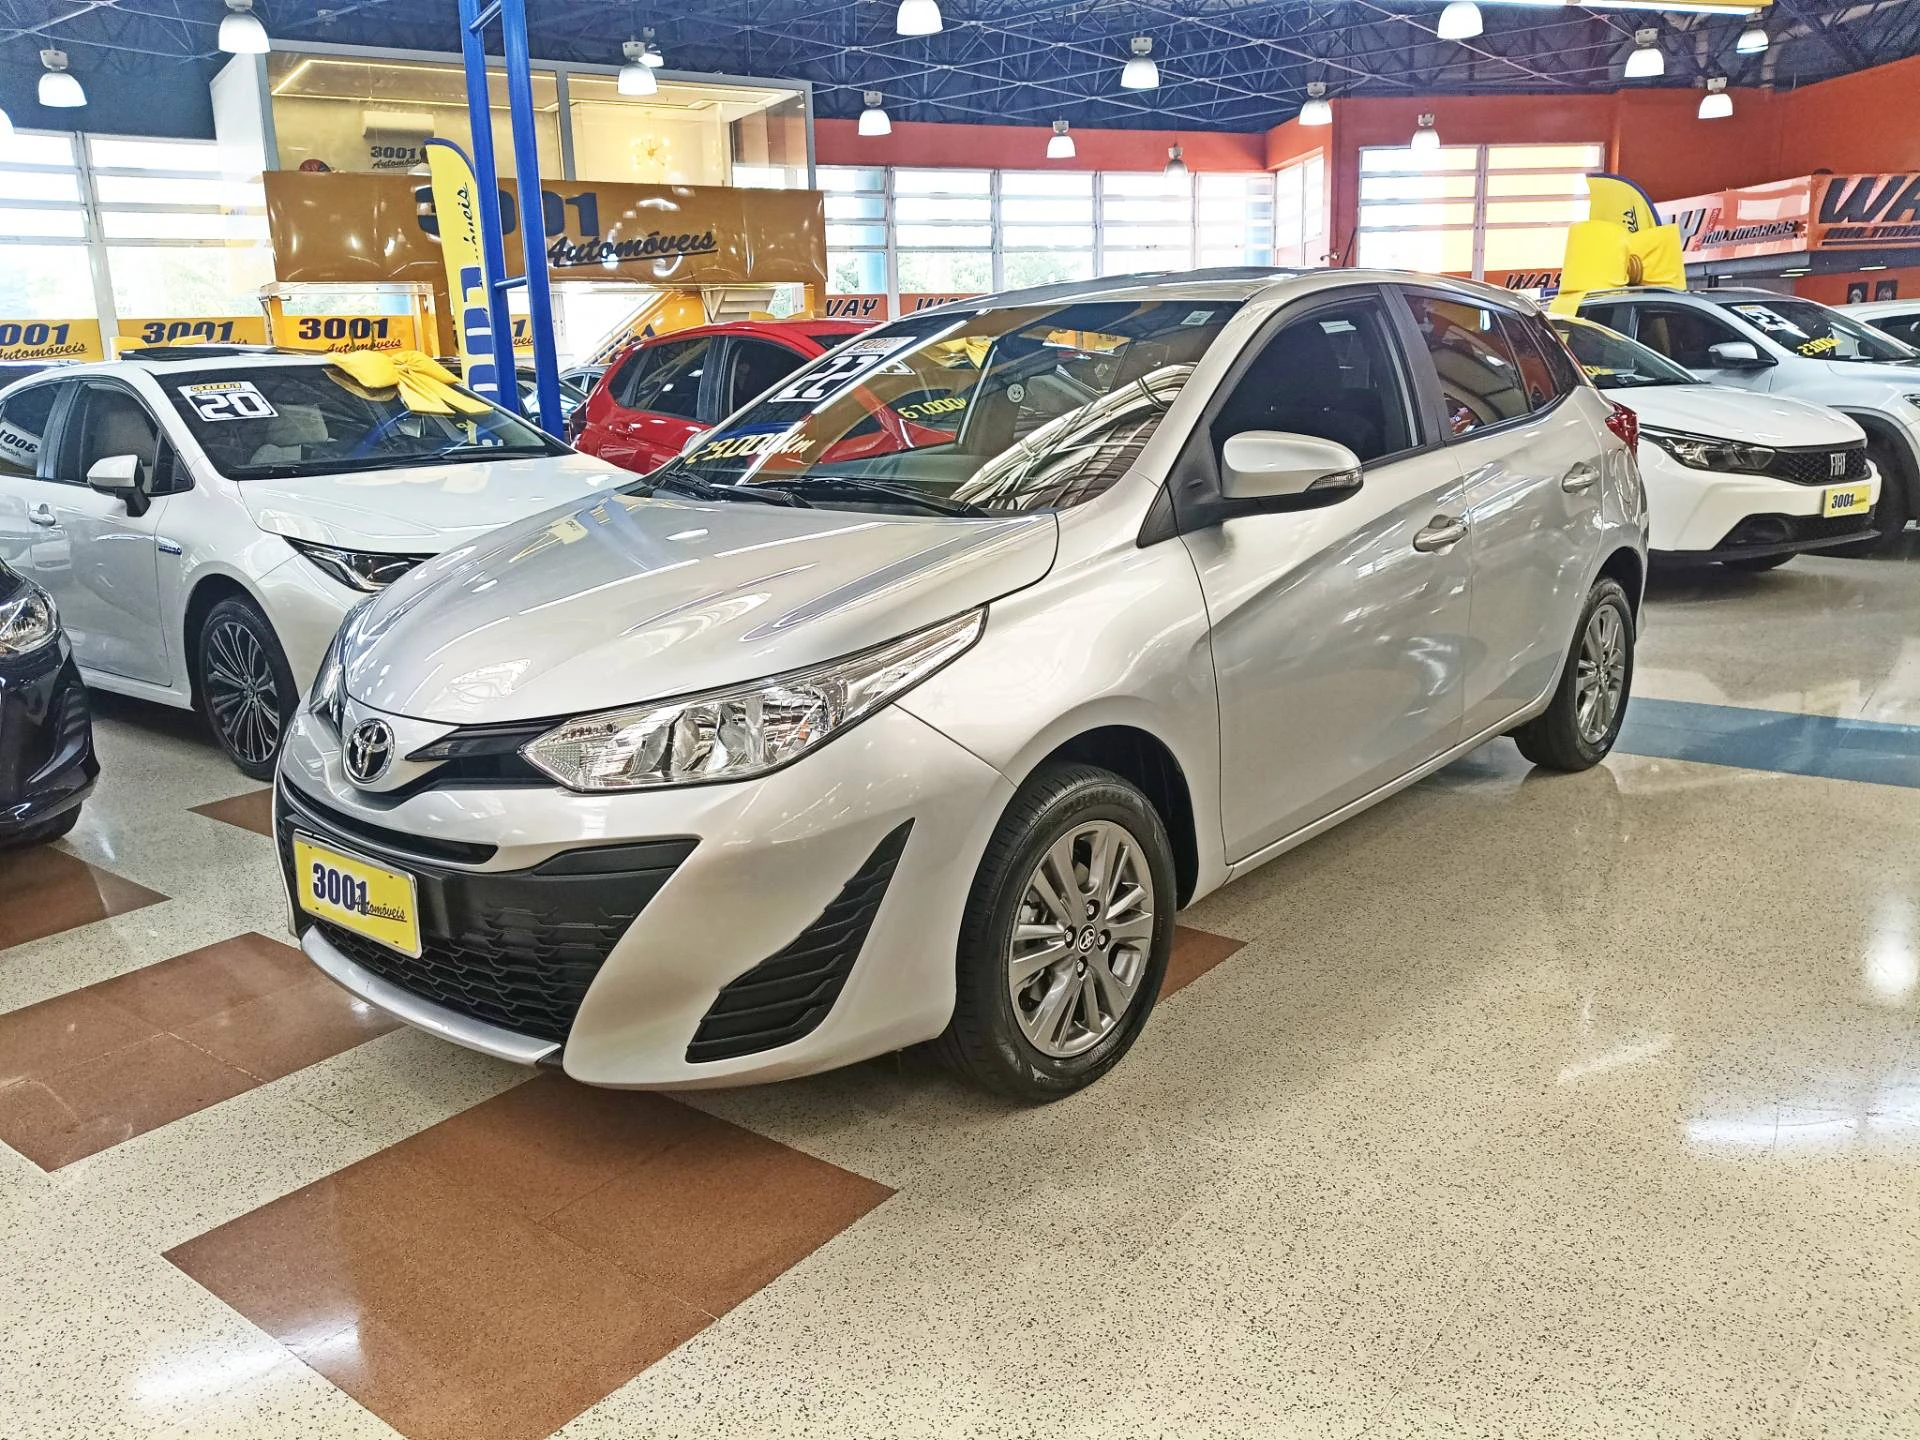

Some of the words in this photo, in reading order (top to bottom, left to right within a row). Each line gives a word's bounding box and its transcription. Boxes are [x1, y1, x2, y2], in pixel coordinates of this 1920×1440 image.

[370, 146, 416, 159] 3001
[548, 231, 718, 267] Automóveis
[299, 318, 388, 340] 3001
[197, 392, 266, 418] 20
[1830, 452, 1846, 476] FIAT
[1832, 493, 1855, 509] 3001
[312, 862, 368, 916] 3001
[354, 894, 407, 921] Atomóveis
